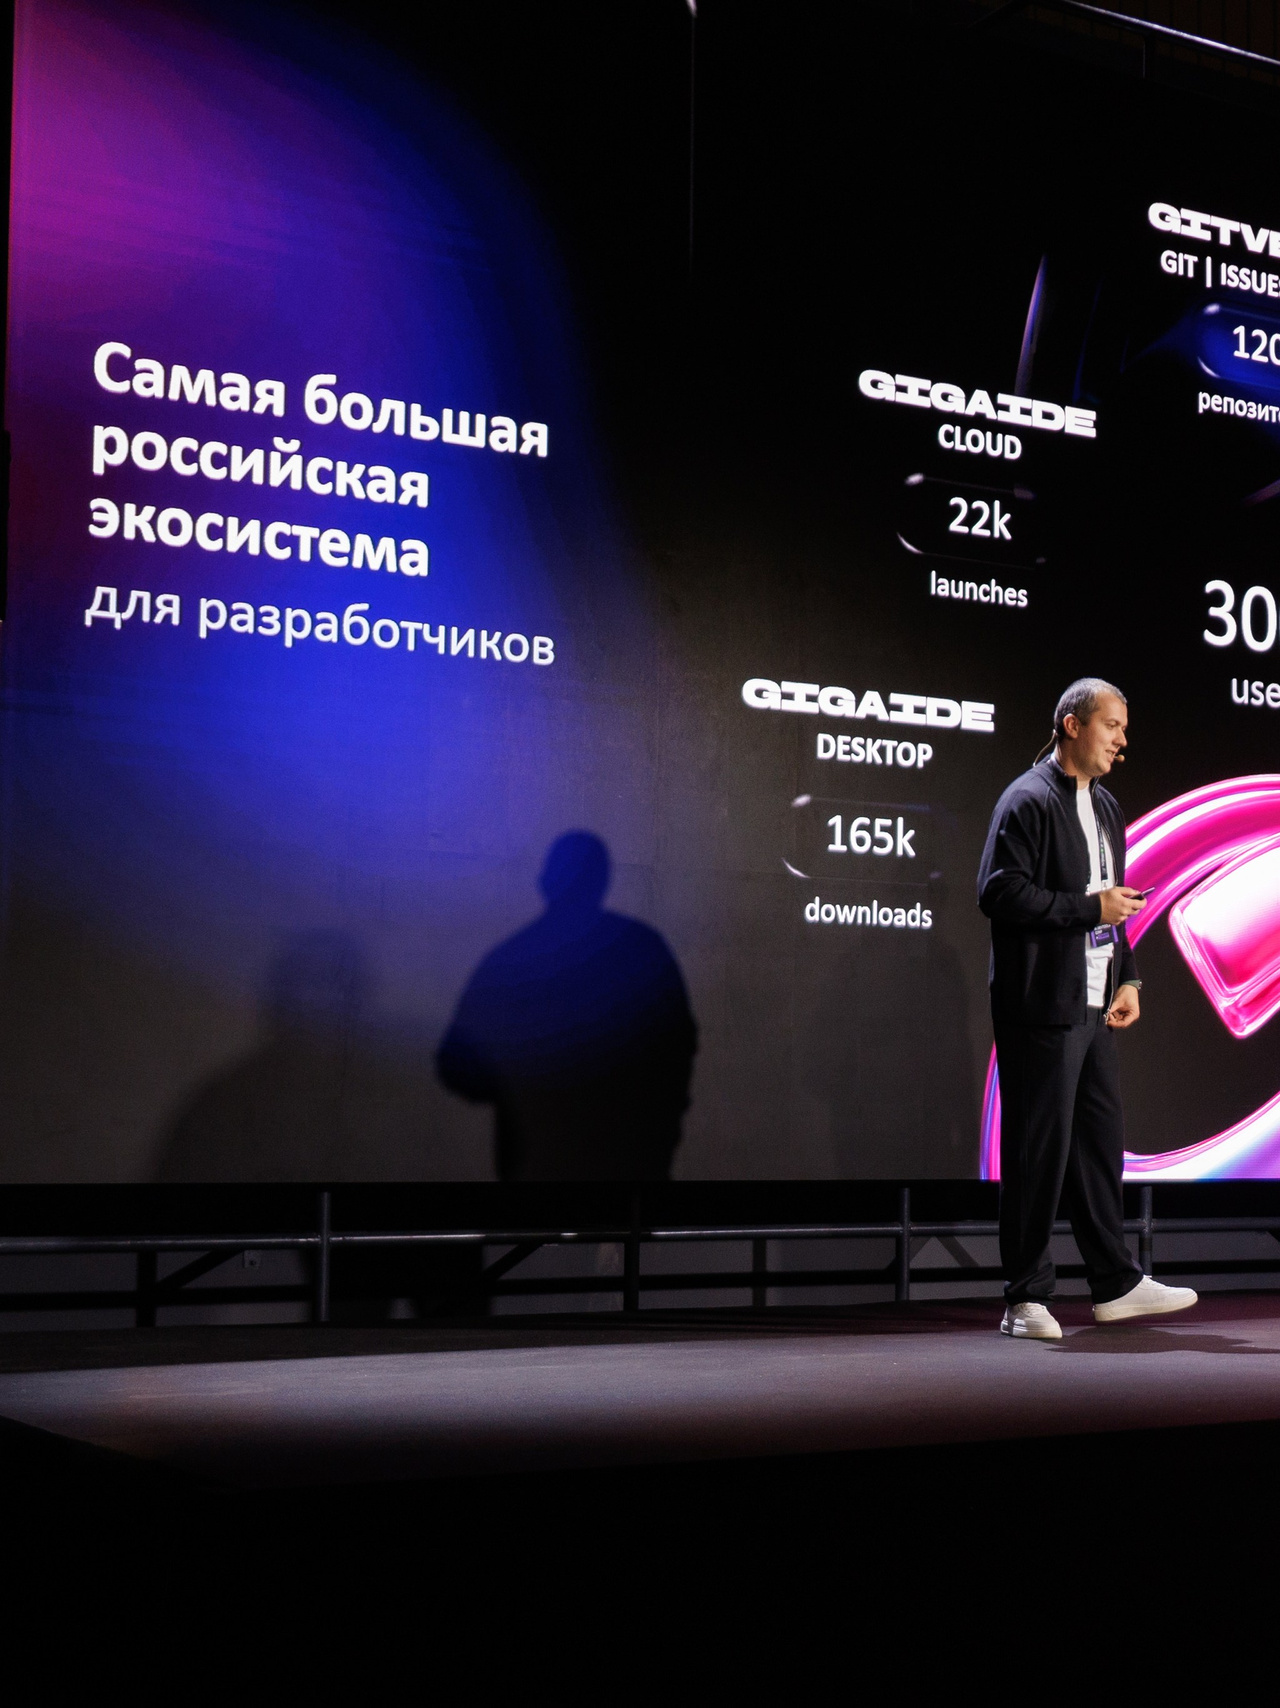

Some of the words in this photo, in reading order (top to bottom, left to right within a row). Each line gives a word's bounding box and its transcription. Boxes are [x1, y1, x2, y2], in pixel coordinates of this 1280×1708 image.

[1160, 249, 1198, 278] GIT
[93, 341, 286, 418] Самая
[303, 373, 548, 457] большая
[858, 369, 1097, 438] GIGAIDE
[937, 424, 1023, 460] CLOUD
[91, 424, 430, 508] российская
[88, 497, 429, 577] экосистема
[948, 496, 1012, 540] 22k
[930, 570, 1028, 608] launches
[84, 585, 181, 630] для
[198, 597, 555, 666] разработчиков
[741, 678, 995, 733] GIGAIDE
[816, 733, 933, 769] DESKTOP
[827, 814, 916, 858] 165k
[804, 895, 933, 929] downloads
